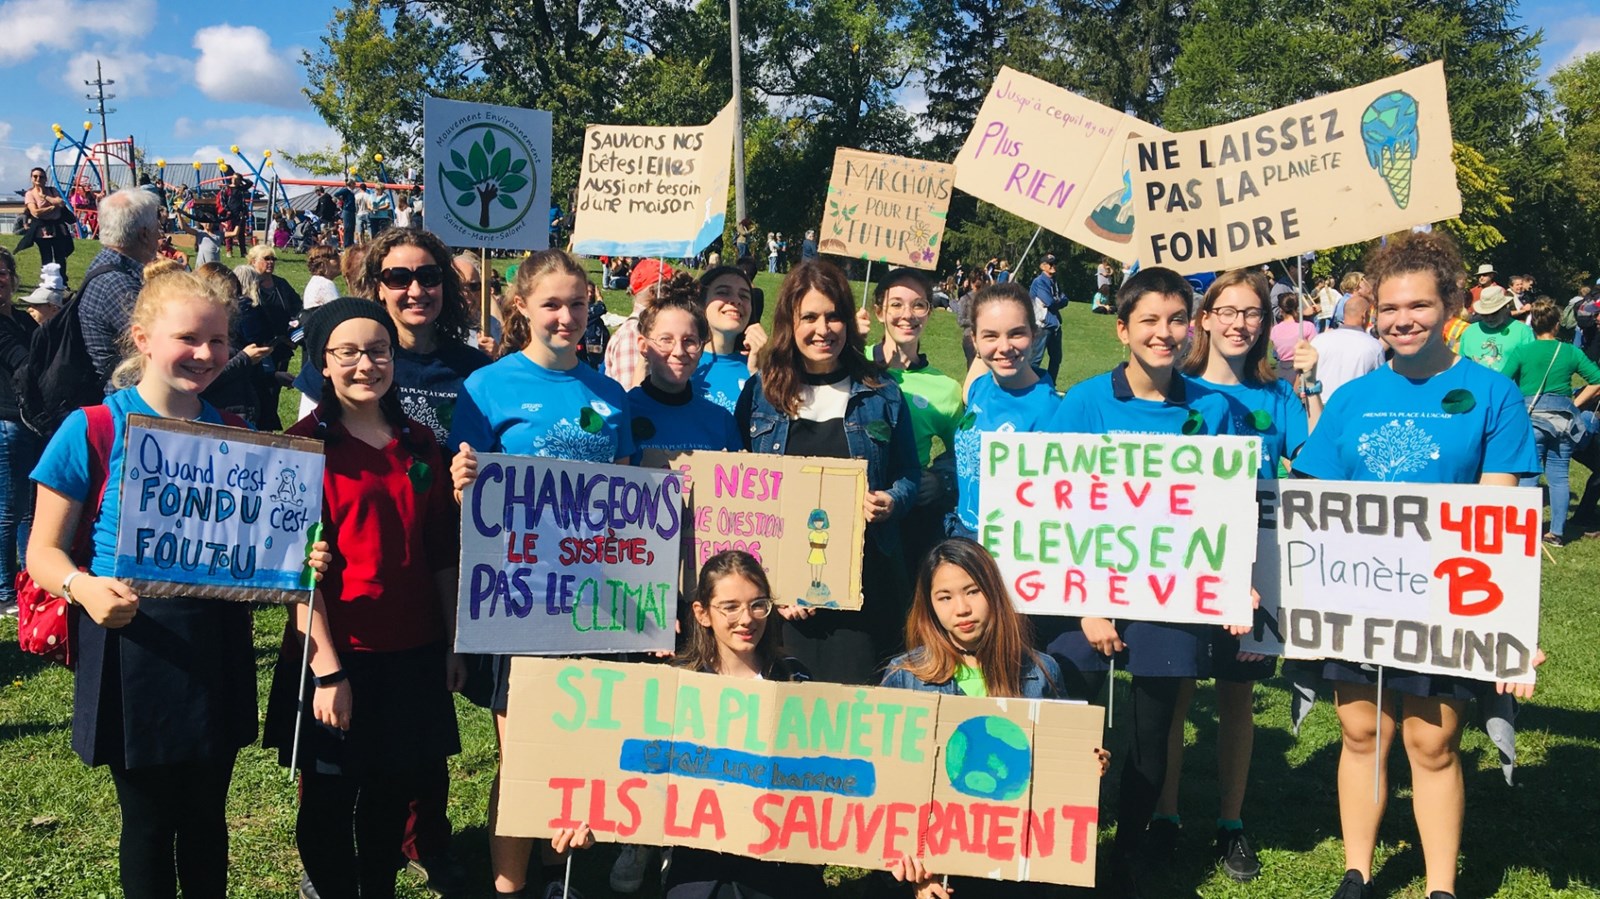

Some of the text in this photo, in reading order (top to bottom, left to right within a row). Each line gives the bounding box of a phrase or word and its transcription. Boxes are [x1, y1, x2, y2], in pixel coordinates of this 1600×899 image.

[436, 111, 541, 164] Mouvement Environnement
[673, 132, 704, 150] NOS
[974, 121, 1024, 160] Plus
[1137, 108, 1345, 172] NE LAISSEZ
[628, 178, 653, 194] ont
[656, 178, 701, 197] besoin
[646, 156, 695, 176] Elles
[845, 160, 950, 200] MARCHONS
[1004, 162, 1076, 209] RIEN
[1146, 152, 1342, 213] PAS LA PLANÈTE
[580, 193, 695, 214] d'une maison
[865, 197, 901, 219] POUR
[1150, 208, 1301, 264] FONDRE
[140, 433, 266, 492] Quand c'est
[989, 435, 1163, 478] PLANÈTE
[139, 476, 308, 532] FONDU c'est
[471, 462, 680, 540] CHANGEONS
[714, 462, 783, 501] N'EST
[1015, 474, 1196, 516] CRÈVE
[507, 530, 539, 564] LE
[717, 506, 785, 539] QUESTION
[1149, 523, 1228, 571] EN
[1440, 501, 1538, 557] 404
[136, 528, 256, 579] FOUTU
[1287, 540, 1504, 616] Planète B
[470, 563, 671, 633] PAS LE CLIMAT
[1014, 566, 1223, 616] GRÈVE
[1253, 606, 1531, 679] NOT FOUND
[551, 665, 930, 763] SI LA PLANÈTE
[722, 758, 766, 784] une
[771, 763, 858, 794] banque
[548, 777, 1098, 867] ILS LA SAUVERAIENT
